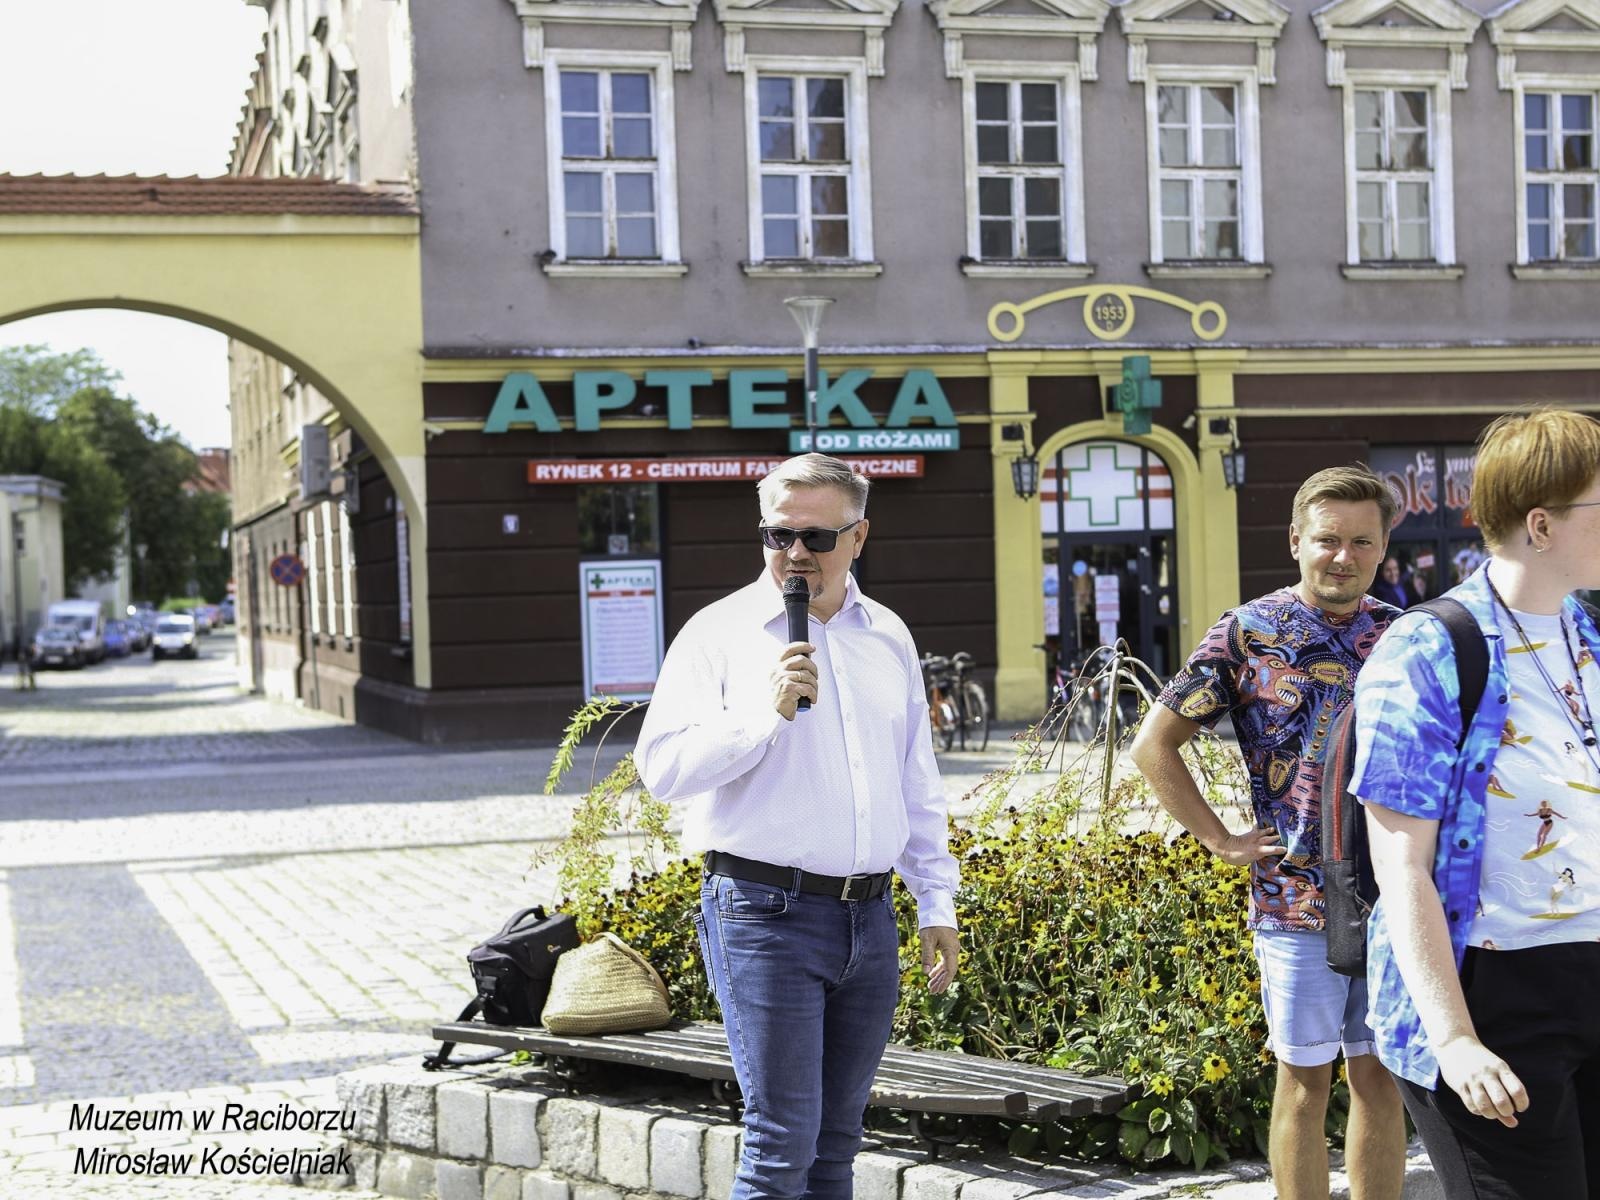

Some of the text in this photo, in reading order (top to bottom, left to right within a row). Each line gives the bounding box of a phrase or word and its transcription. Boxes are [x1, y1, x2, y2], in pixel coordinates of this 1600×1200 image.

[1096, 306, 1124, 320] 1953
[482, 368, 958, 433] APTEKA
[800, 430, 951, 449] POD RÓŻAMI
[537, 464, 604, 479] RYNEK
[609, 464, 632, 478] 12
[647, 462, 738, 478] CENTRUM
